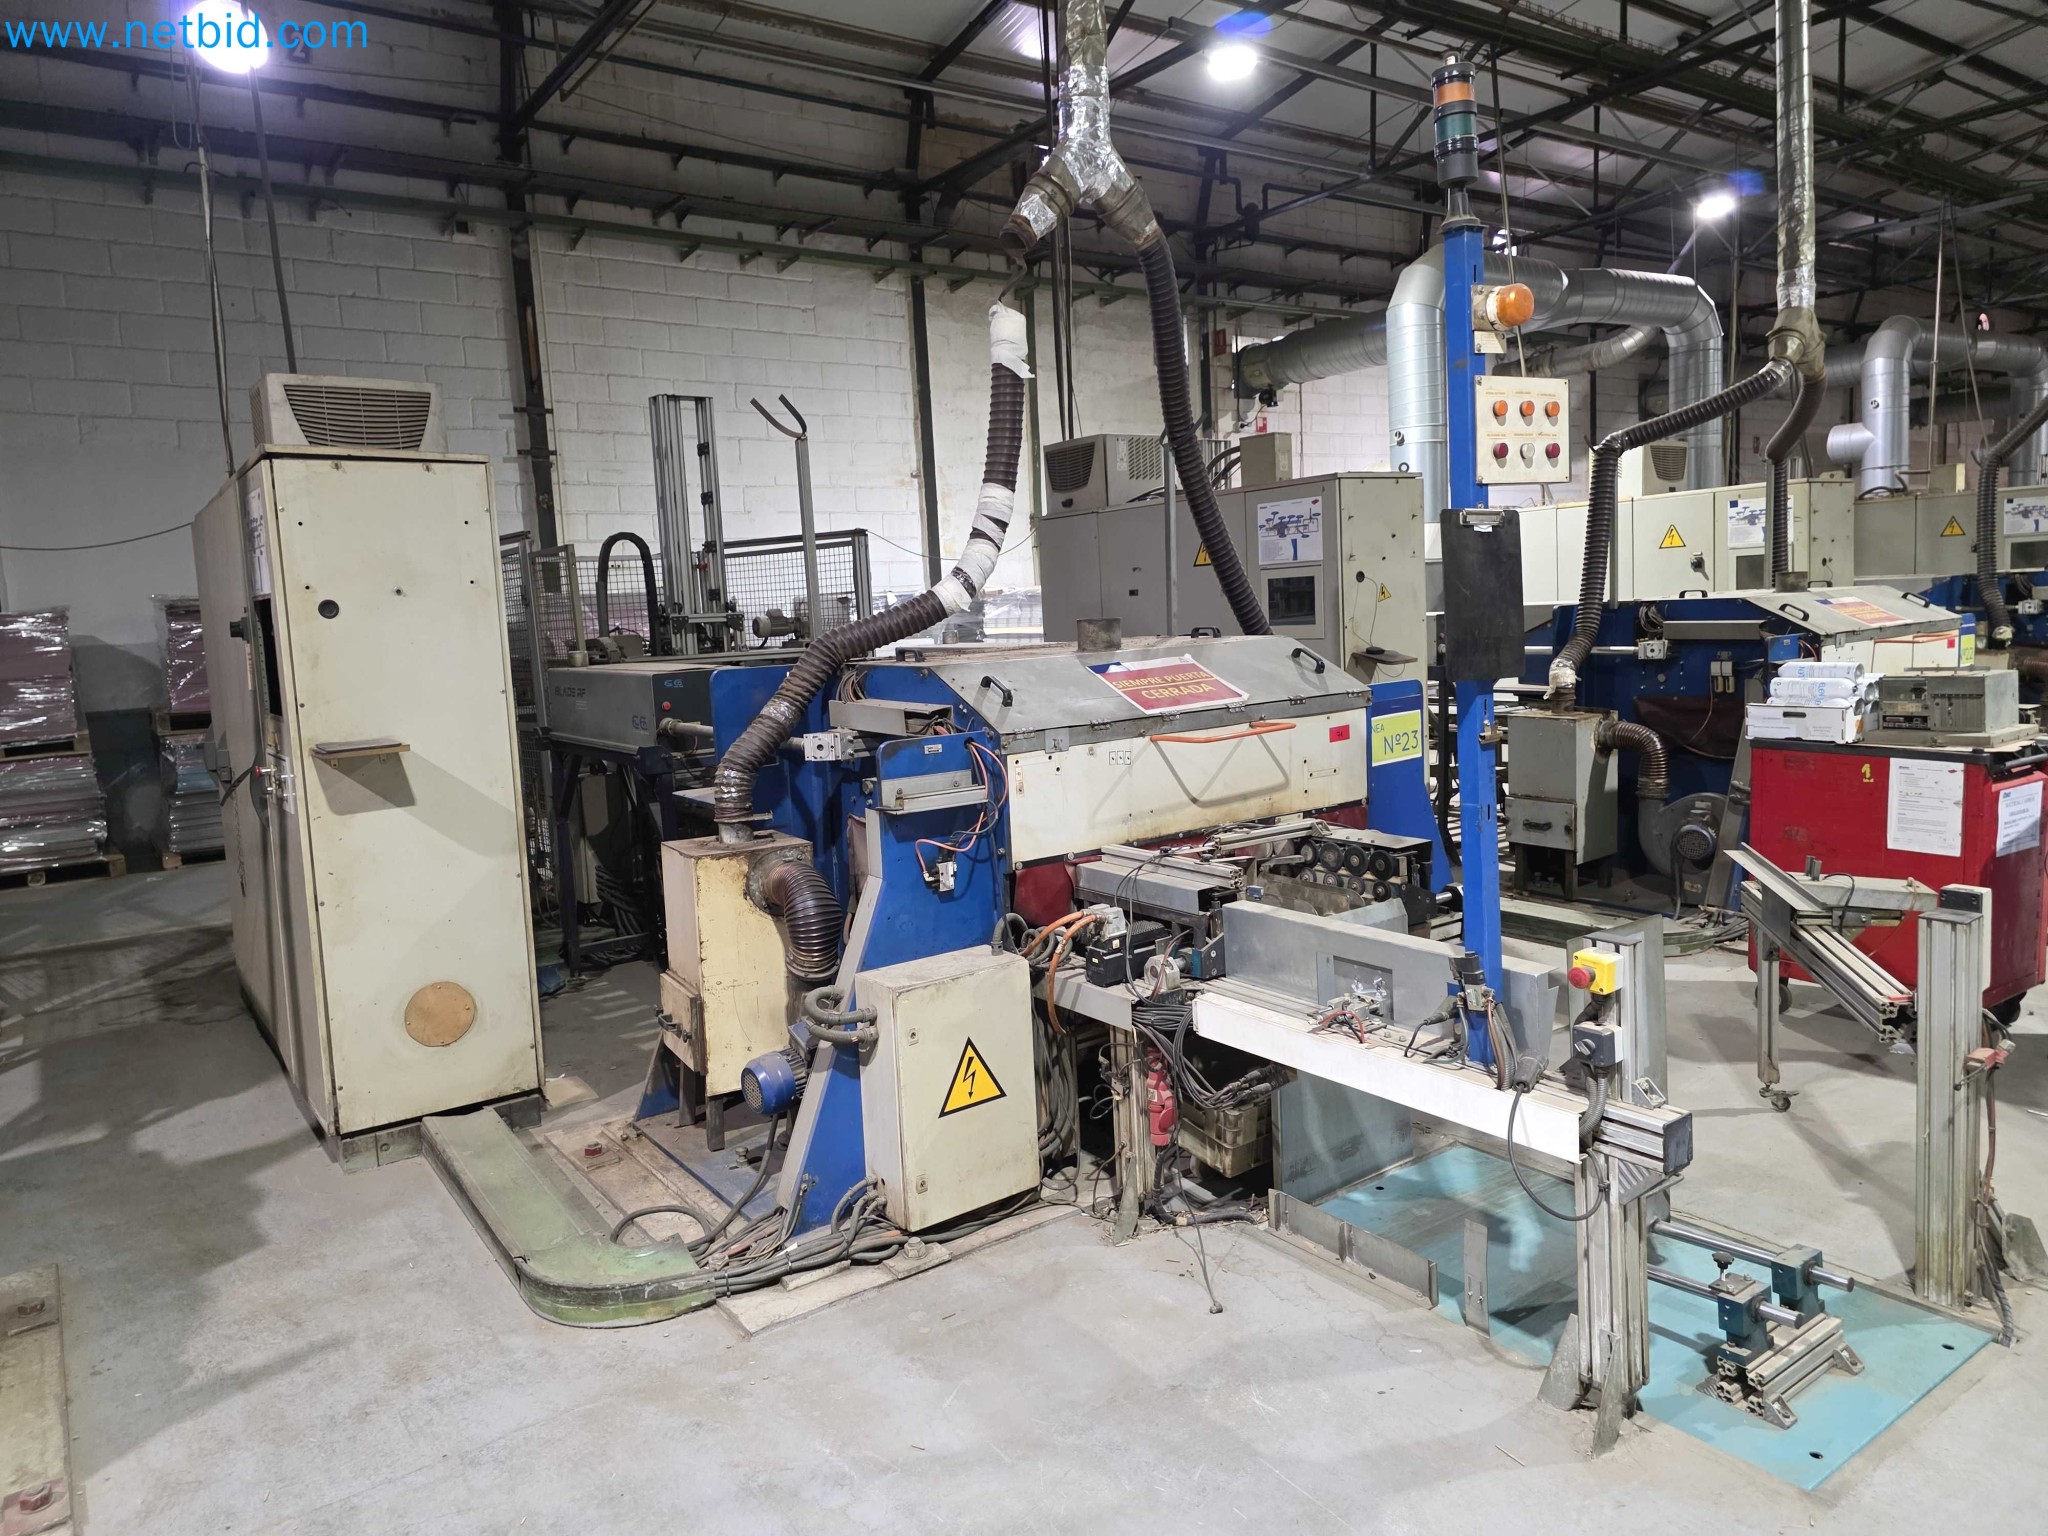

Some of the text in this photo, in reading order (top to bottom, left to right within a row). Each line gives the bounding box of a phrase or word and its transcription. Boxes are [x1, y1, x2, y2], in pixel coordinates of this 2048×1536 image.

[1112, 671, 1211, 689] SIEMPRE PUERTA
[1141, 683, 1216, 699] CERRADA
[1861, 763, 1874, 783] 1
